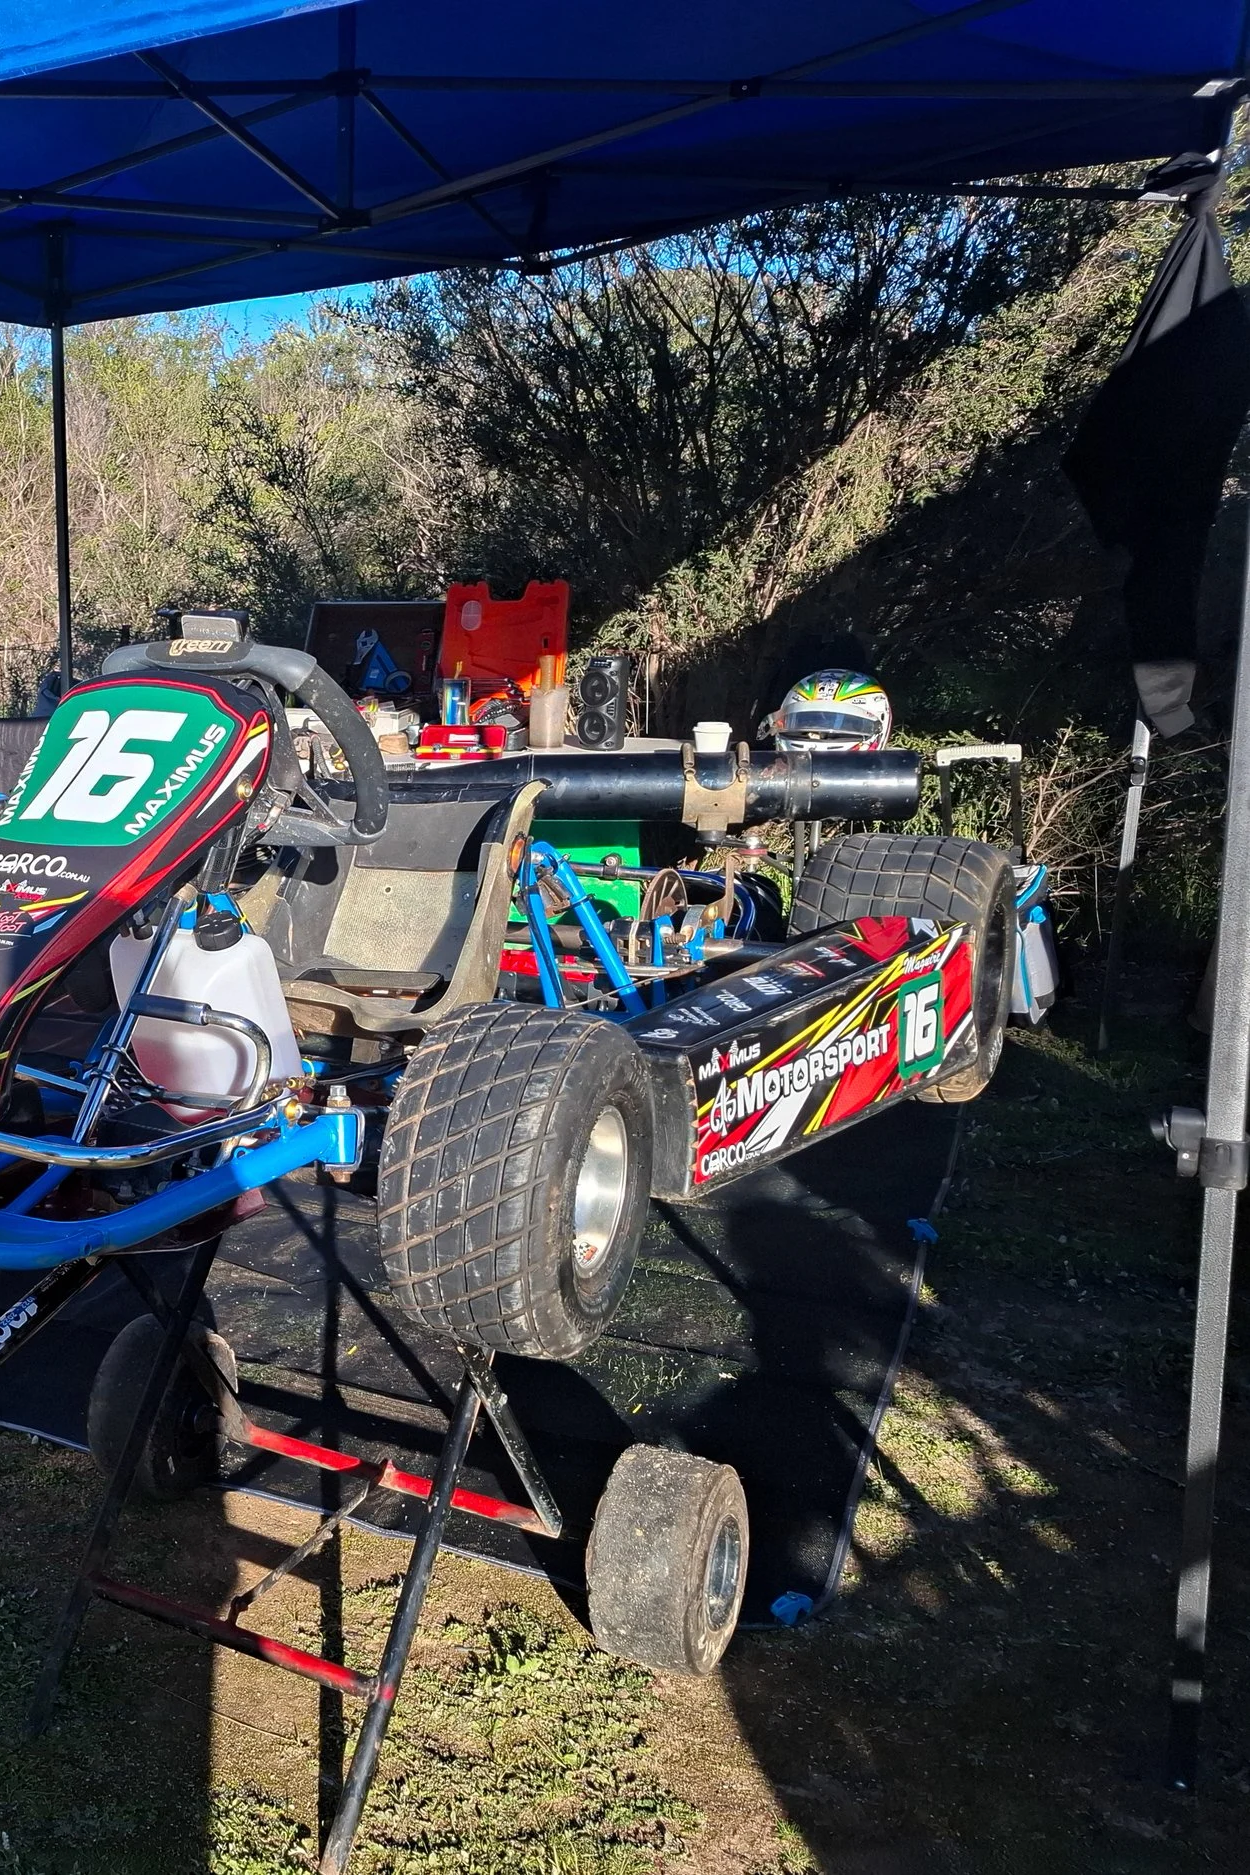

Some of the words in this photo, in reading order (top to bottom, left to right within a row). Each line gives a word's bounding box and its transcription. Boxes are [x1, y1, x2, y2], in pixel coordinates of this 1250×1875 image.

[19, 709, 188, 823] 16
[124, 723, 226, 836] MAXIMUS
[699, 1041, 760, 1081] MAXIMUS
[903, 983, 940, 1063] 16
[735, 1022, 892, 1120] MOTORSPORT
[701, 1141, 745, 1176] CARCO
